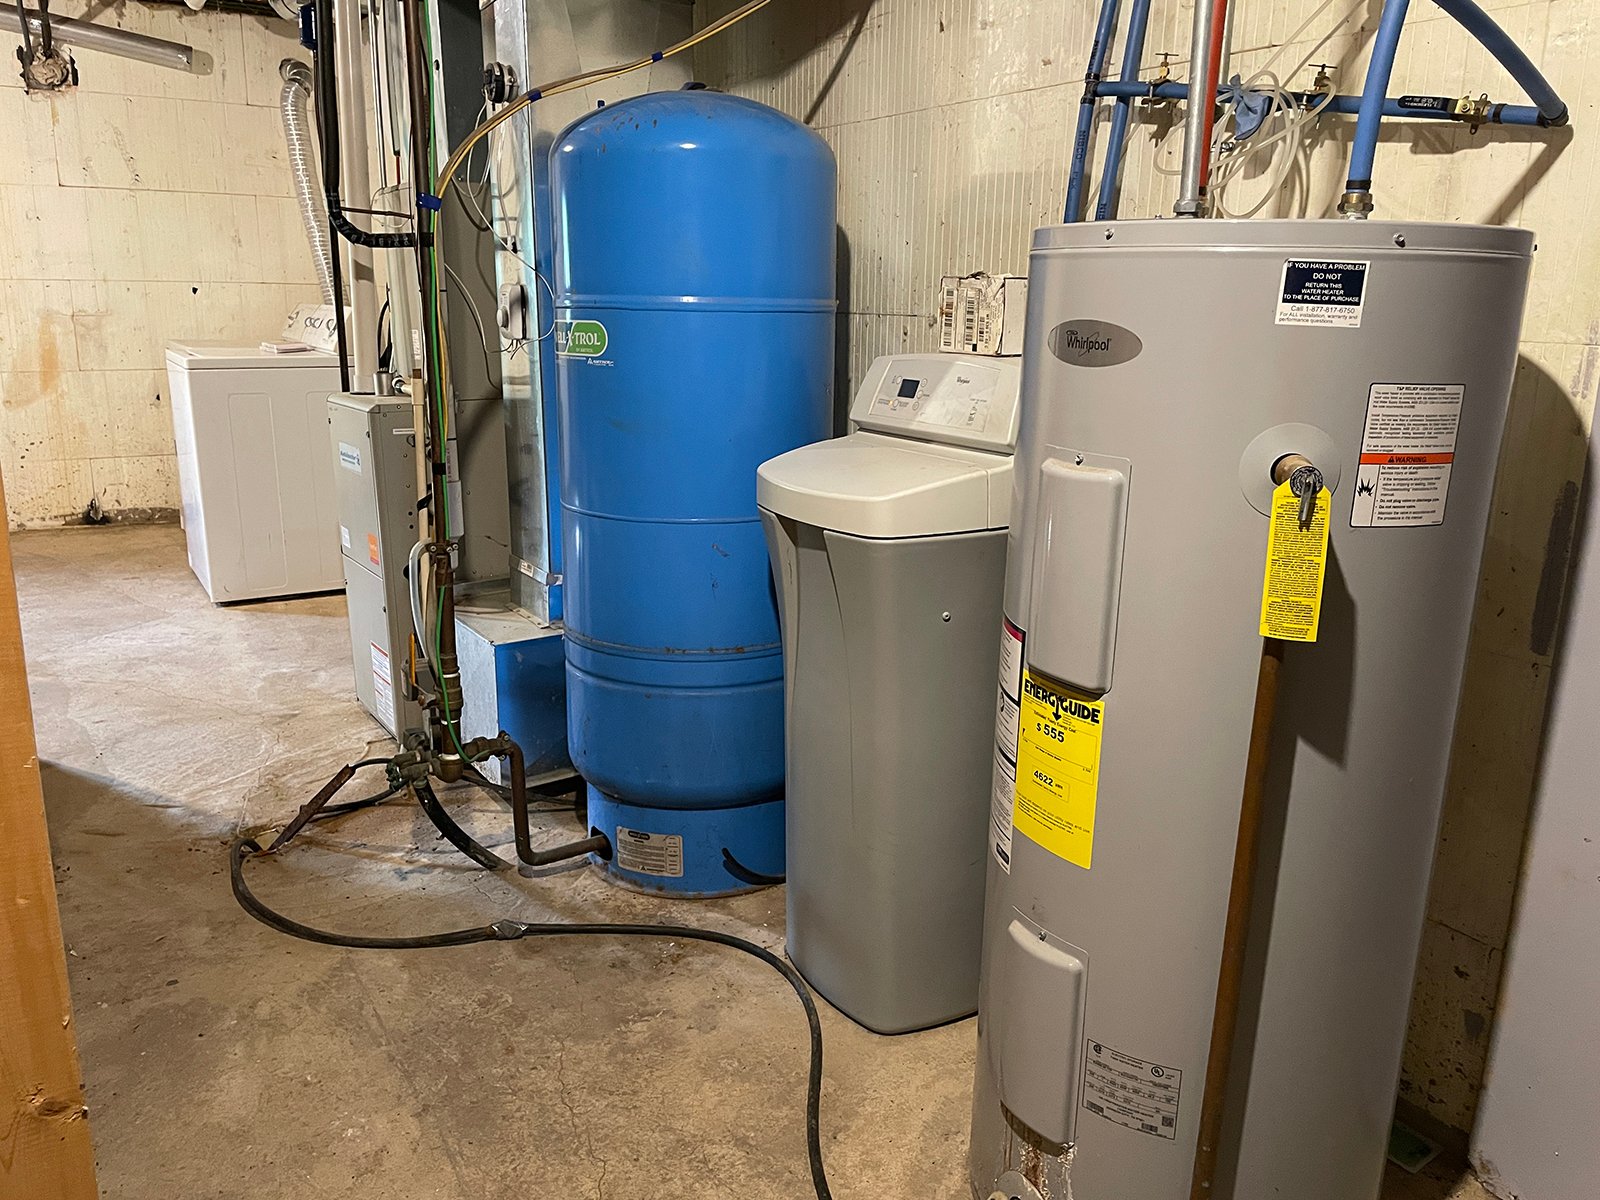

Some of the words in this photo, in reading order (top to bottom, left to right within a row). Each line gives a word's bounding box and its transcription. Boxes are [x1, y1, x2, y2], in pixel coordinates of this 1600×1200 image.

[1312, 272, 1325, 280] DO
[1306, 306, 1356, 314] 1-877-817-6750
[1066, 334, 1111, 354] Whirlpool
[1036, 722, 1042, 732] $
[1043, 723, 1065, 743] 555
[1033, 770, 1054, 788] 4622
